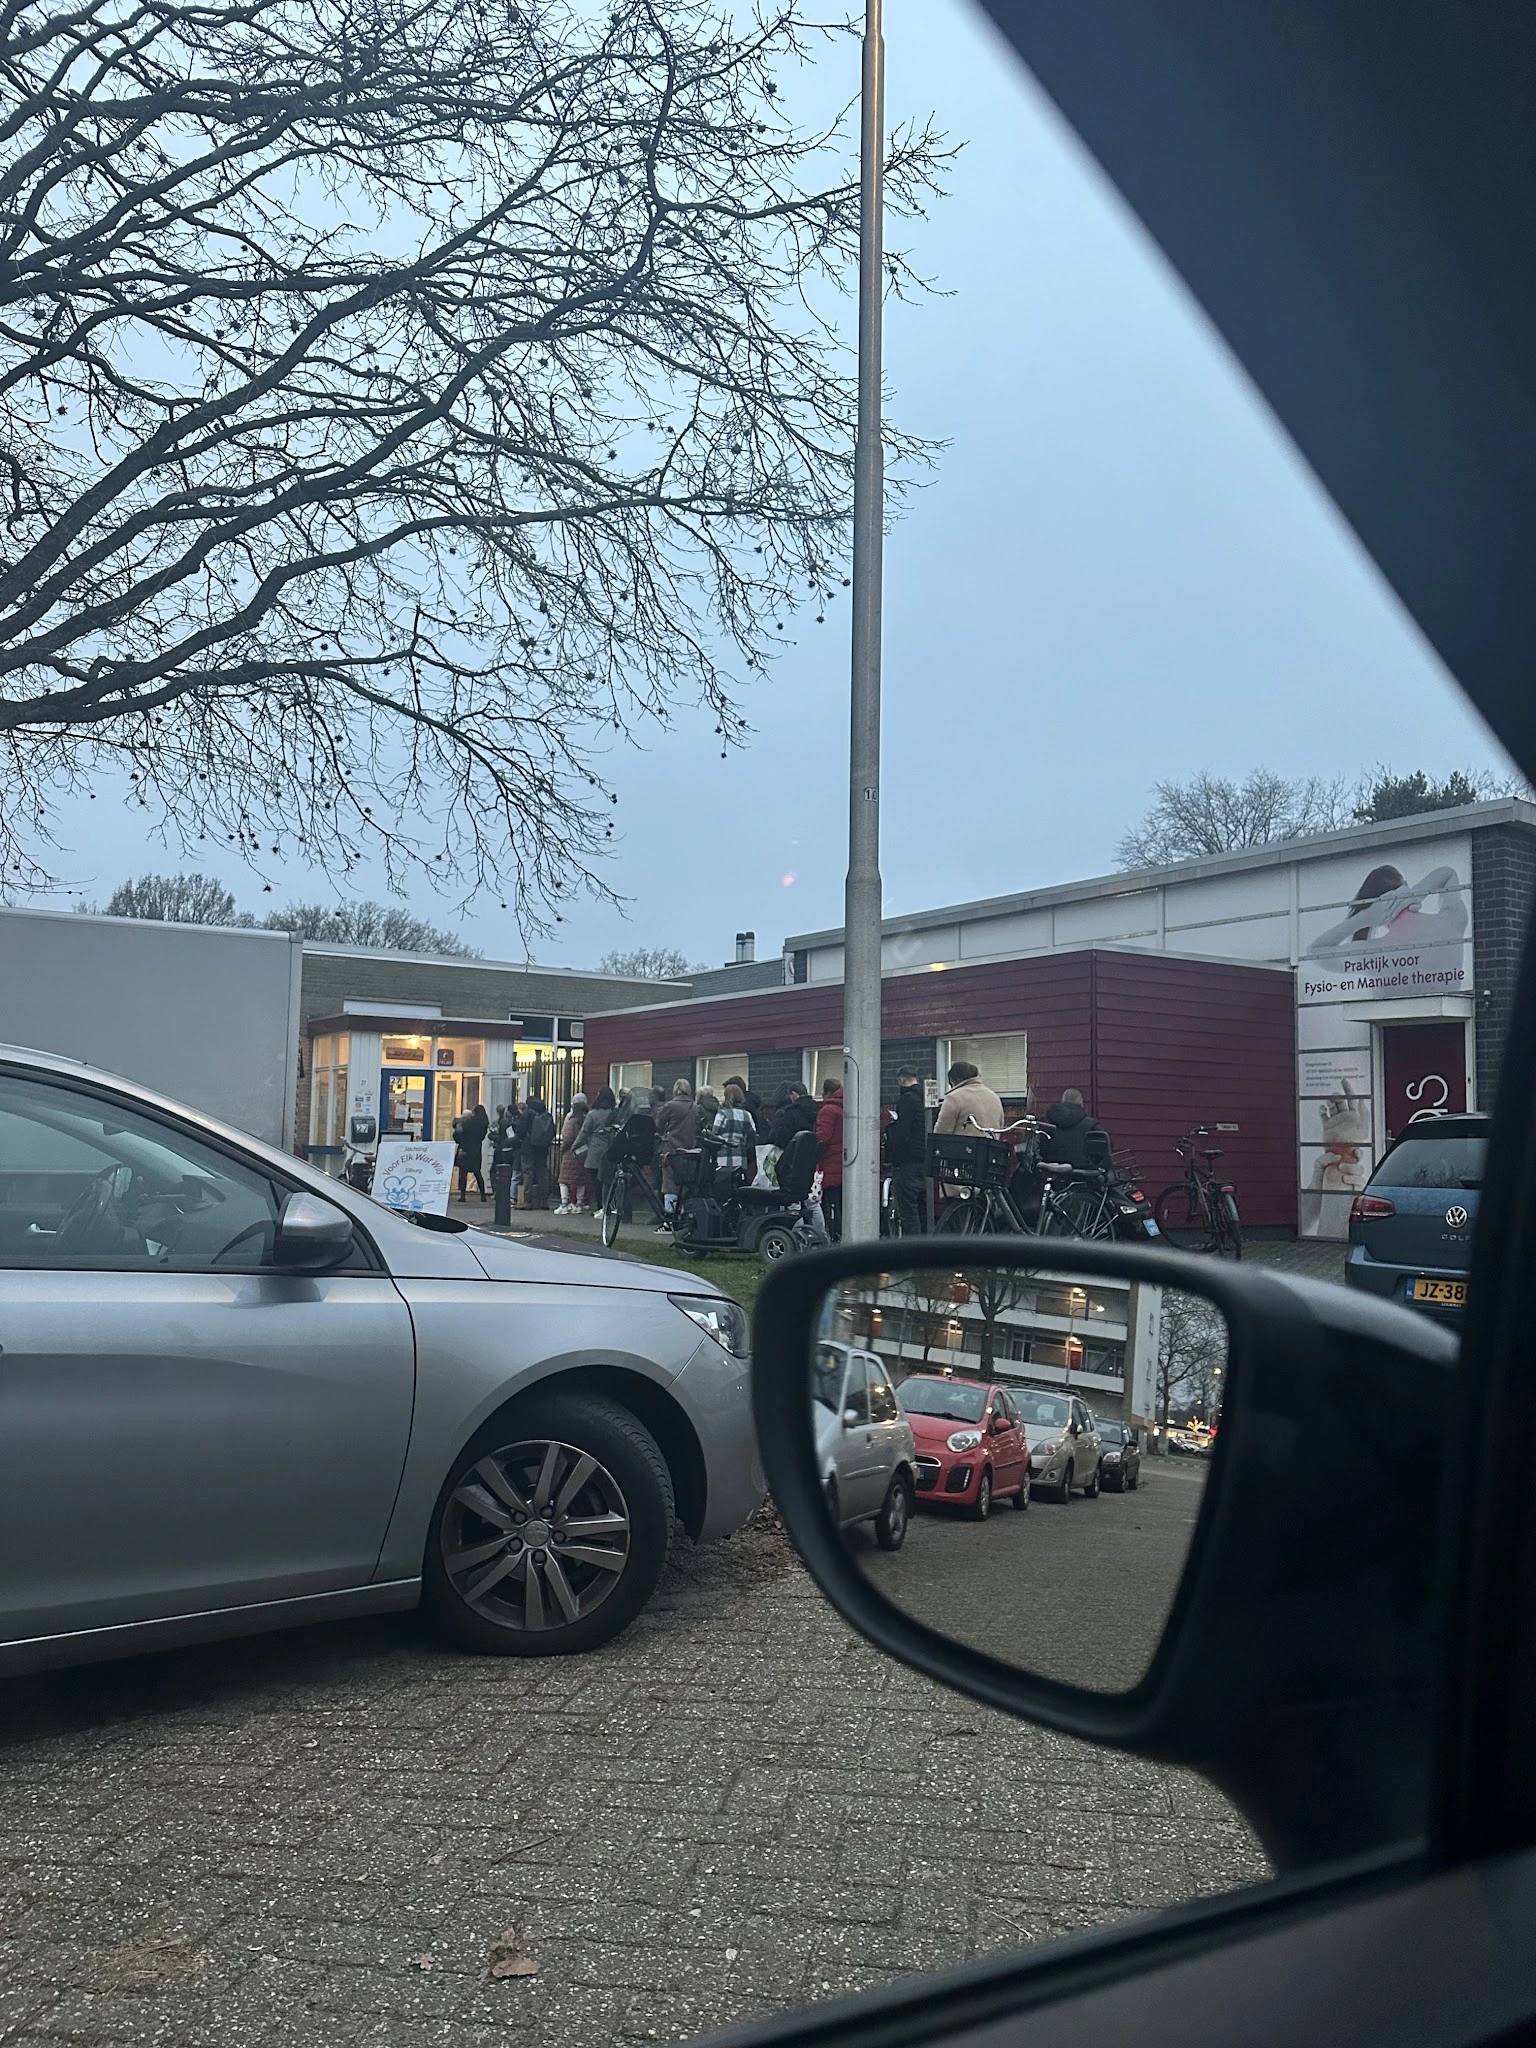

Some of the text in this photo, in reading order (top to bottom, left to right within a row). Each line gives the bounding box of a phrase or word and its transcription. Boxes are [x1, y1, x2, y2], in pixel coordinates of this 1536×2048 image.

[1344, 955, 1420, 972] Praktijk voor
[1305, 968, 1465, 996] Fysio- en Manuele therapie
[383, 1153, 445, 1176] Voor Elk Wat Wils
